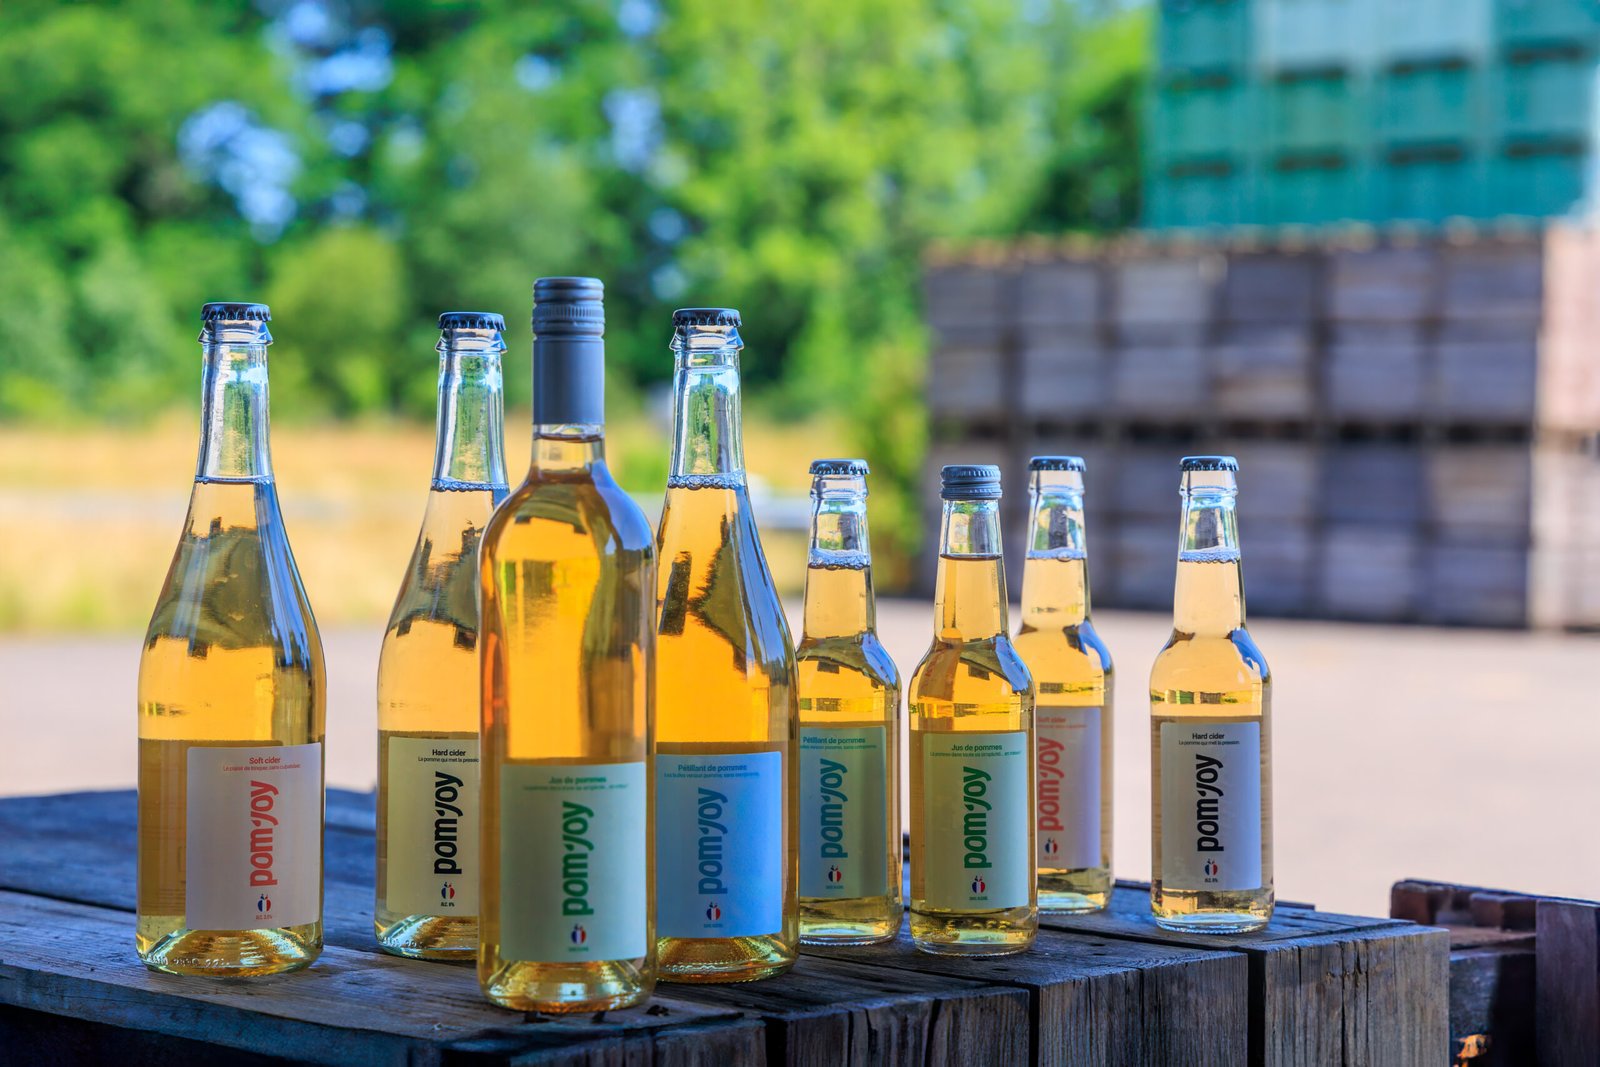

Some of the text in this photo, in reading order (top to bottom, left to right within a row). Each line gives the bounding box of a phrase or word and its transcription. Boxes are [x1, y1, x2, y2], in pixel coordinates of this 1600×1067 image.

[1192, 732, 1225, 740] Hard cider
[838, 737, 866, 745] pommes
[974, 744, 1003, 752] pommes
[249, 756, 281, 765] Soft cider
[707, 764, 716, 772] de
[717, 764, 748, 773] pommes
